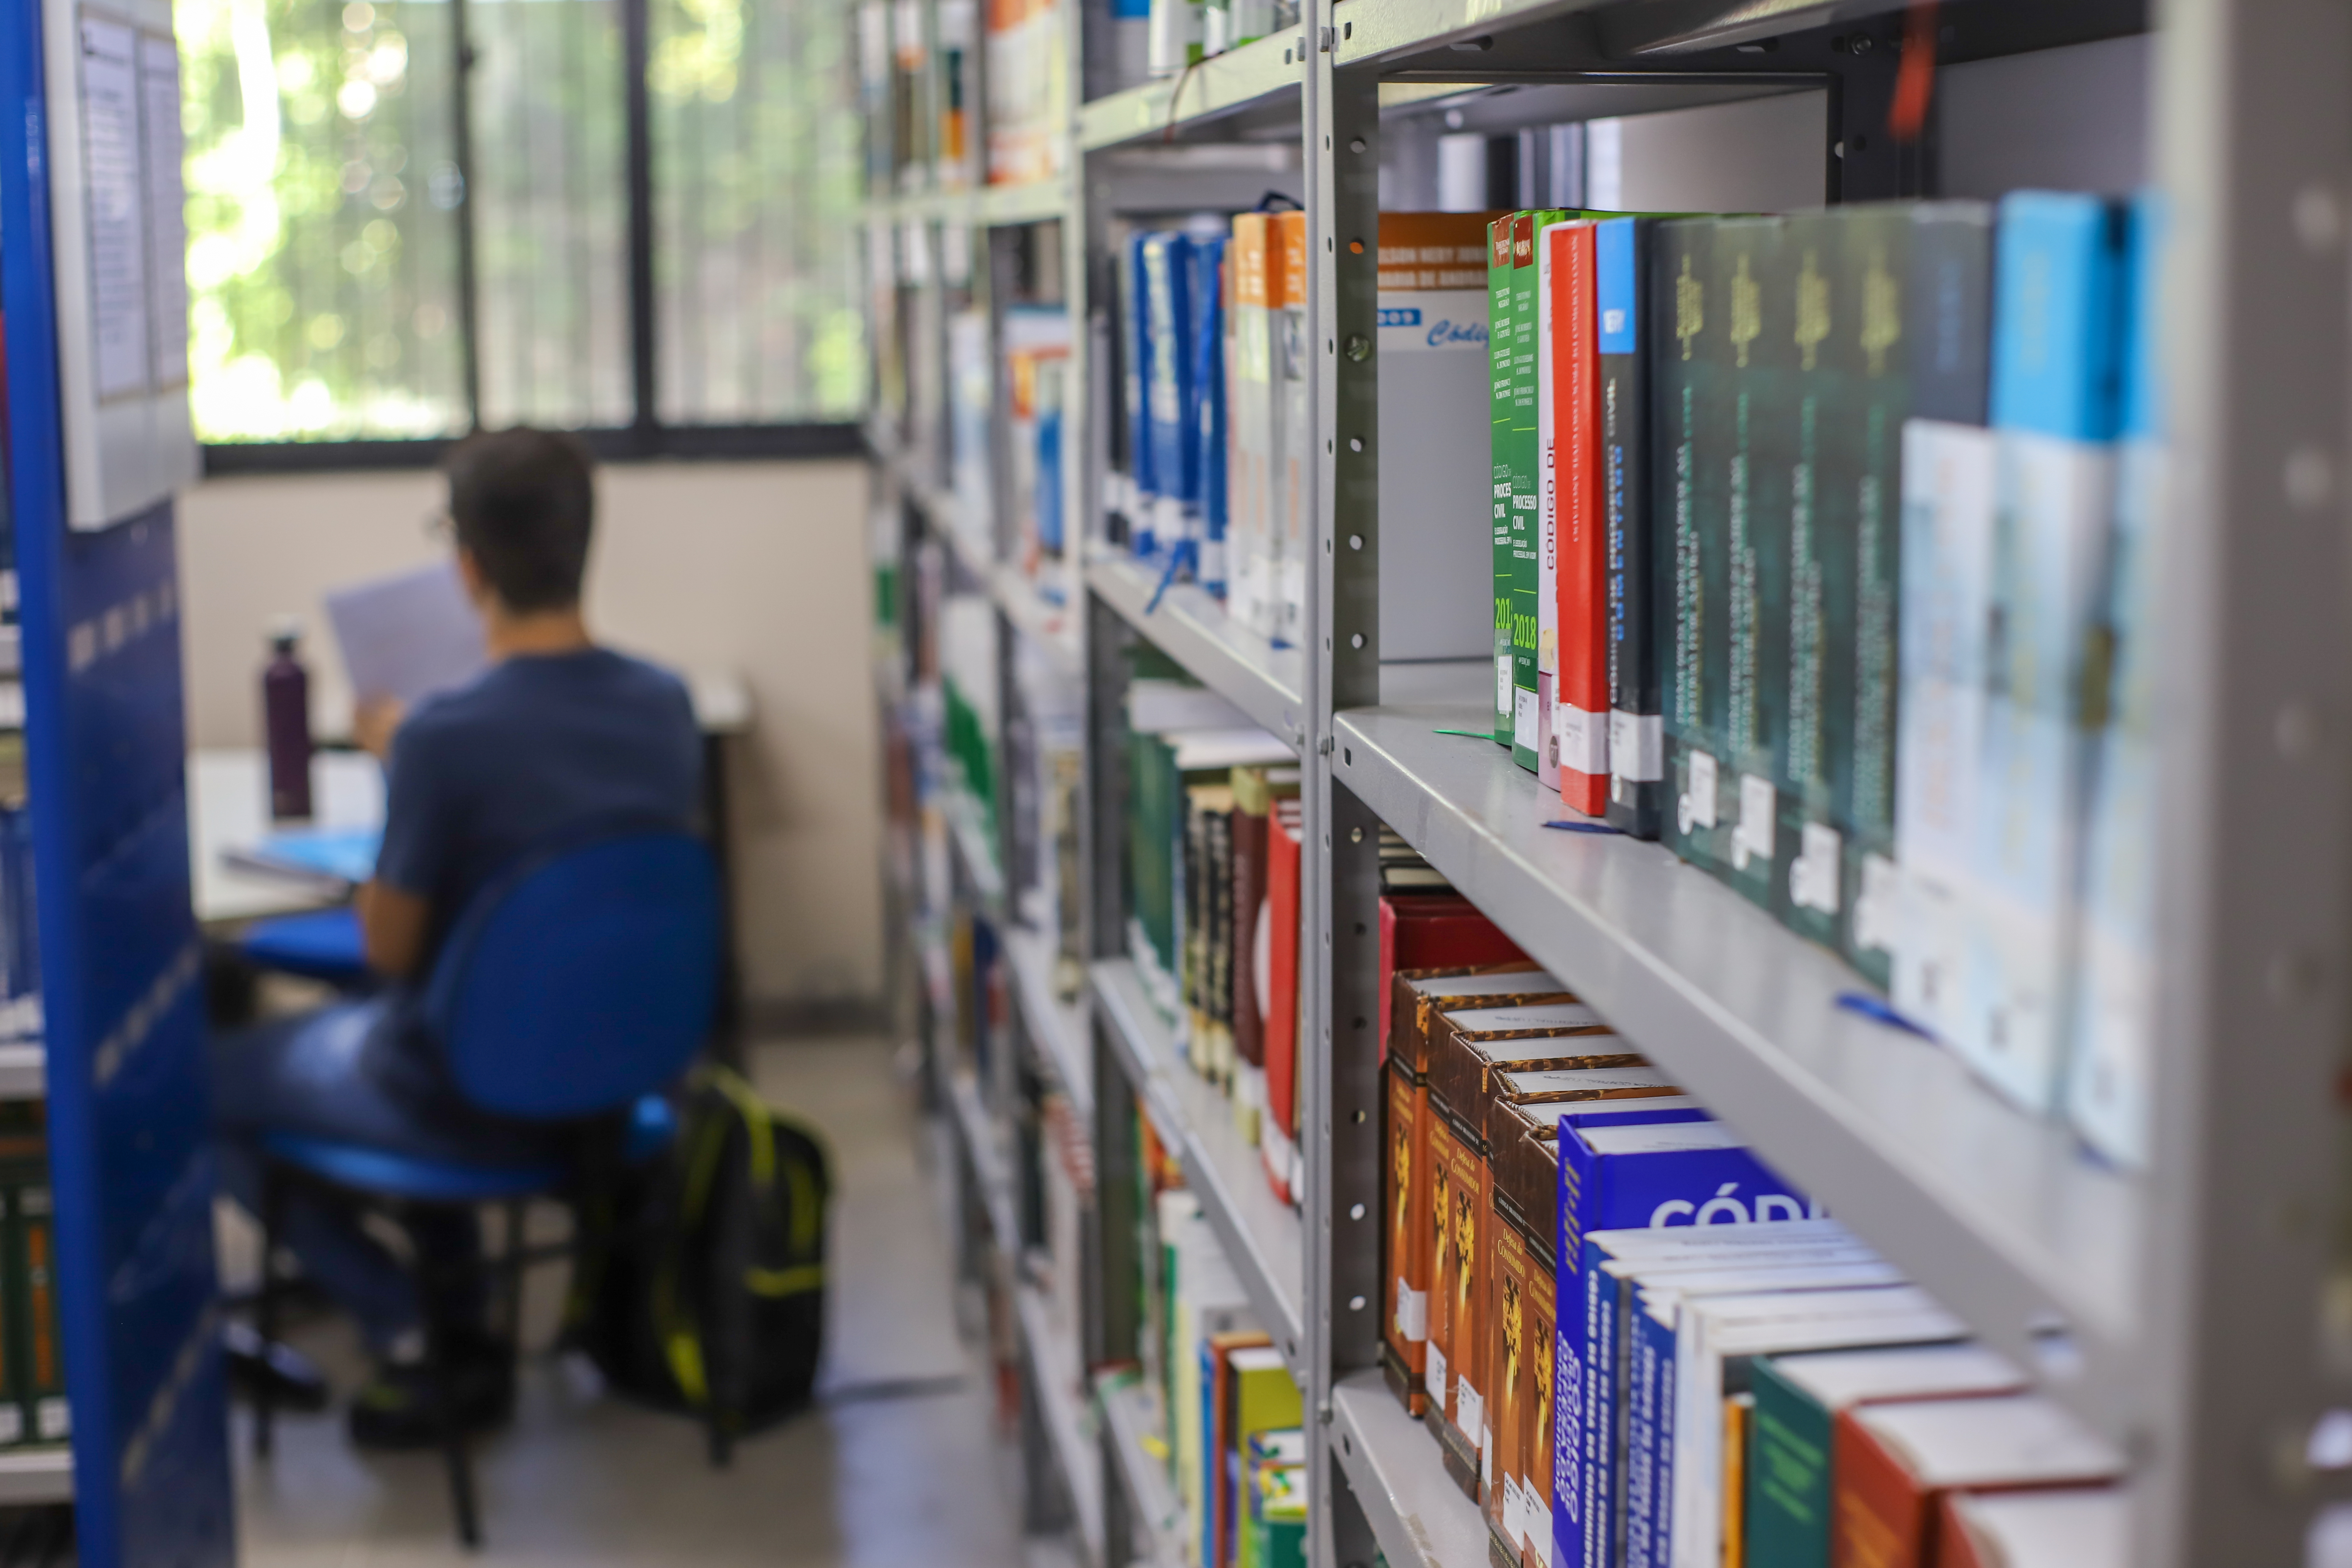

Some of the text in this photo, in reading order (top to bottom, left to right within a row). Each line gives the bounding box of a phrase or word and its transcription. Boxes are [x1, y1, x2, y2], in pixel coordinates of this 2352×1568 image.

[1493, 463, 1508, 479] CÓDIGO
[1512, 473, 1527, 489] CÓDIGO
[1494, 503, 1506, 519] CIVIL
[1512, 495, 1537, 510] PROCESSO
[1513, 515, 1525, 530] CIVIL
[1546, 480, 1554, 570] CÓDIGO
[1513, 613, 1537, 650] 2018
[1503, 1228, 1517, 1251] Defesa
[1517, 1242, 1522, 1256] do
[1497, 1239, 1526, 1279] CONSUMIDO
[1587, 1342, 1598, 1366] DE
[1586, 1368, 1597, 1429] DEFESA
[1570, 1356, 1582, 1524] CÓDIGO
[1586, 1432, 1596, 1459] DO
[1583, 1462, 1595, 1568] CONSUMIDO
